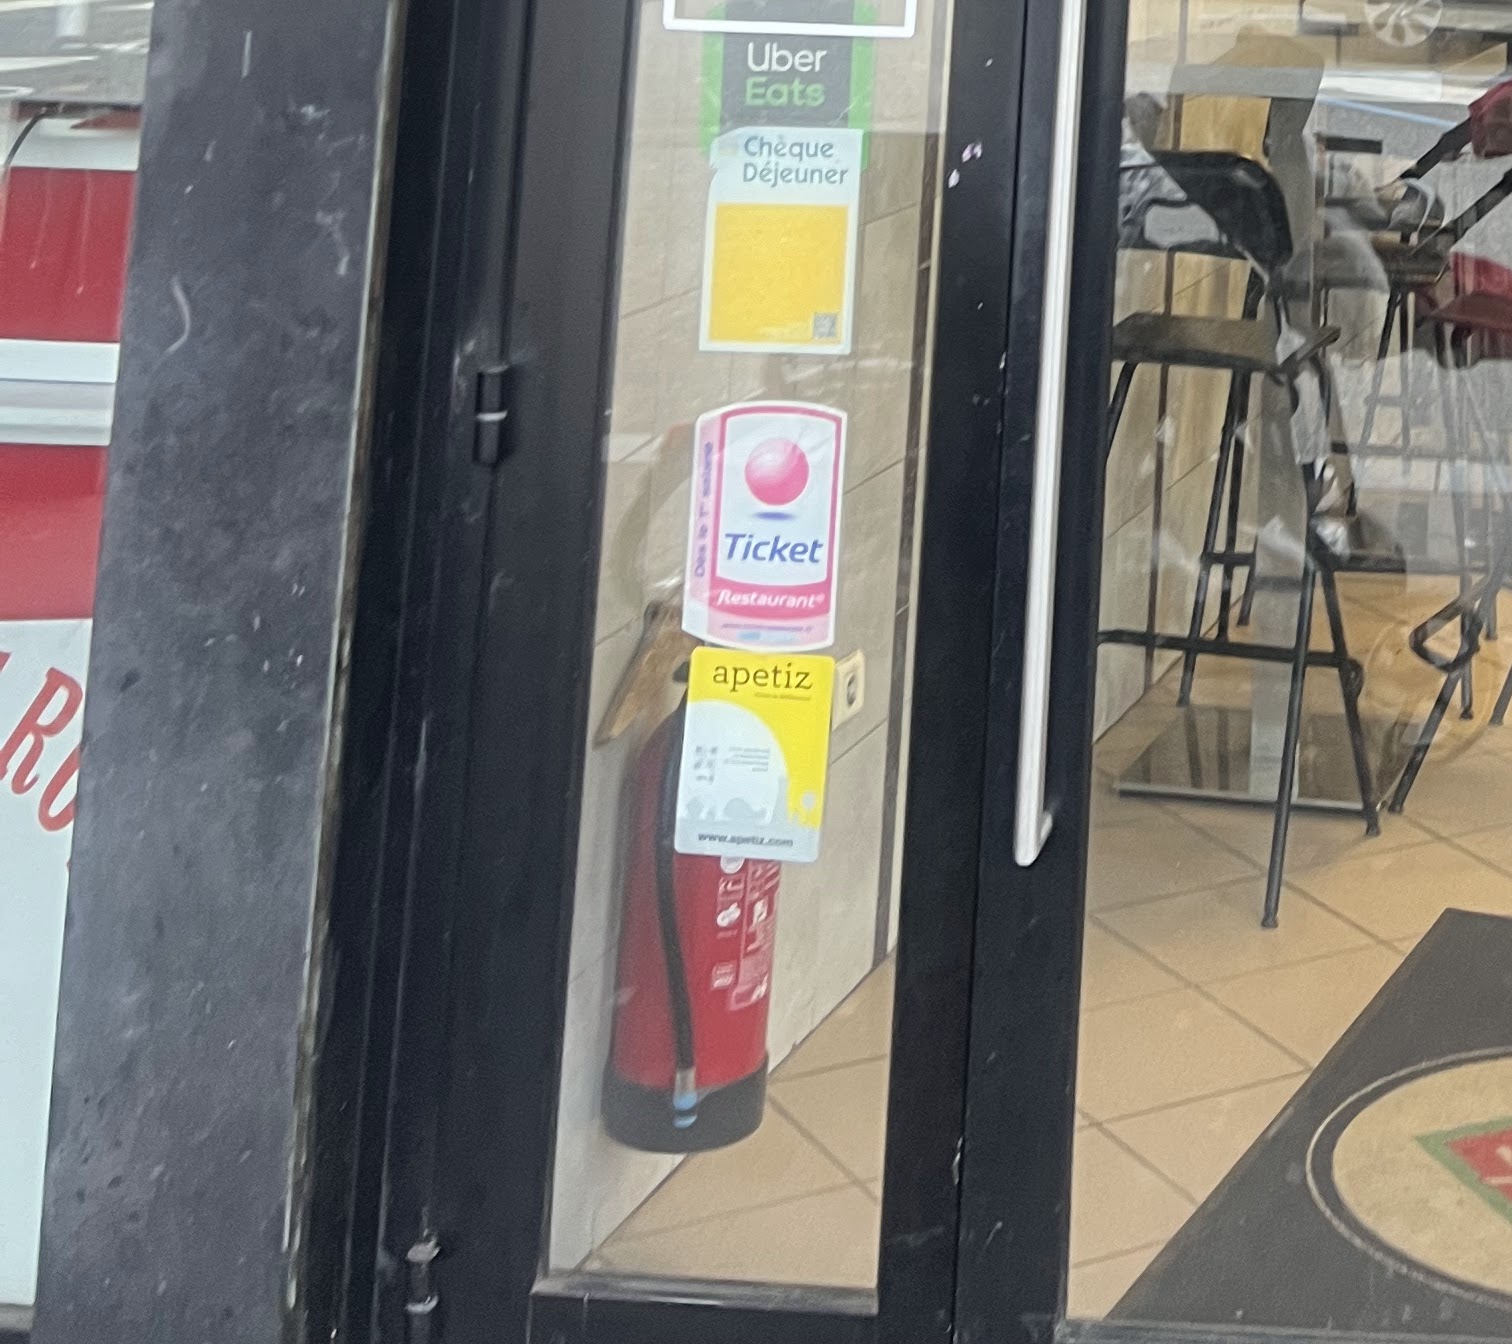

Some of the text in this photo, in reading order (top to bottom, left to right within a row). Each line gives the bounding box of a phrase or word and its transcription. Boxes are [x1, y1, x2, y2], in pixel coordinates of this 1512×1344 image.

[746, 42, 827, 73] Uber
[745, 77, 826, 108] Eats
[743, 135, 834, 168] Chèque
[742, 161, 849, 187] Déjeuner
[725, 532, 824, 563] Ticket
[713, 662, 813, 693] apetiz
